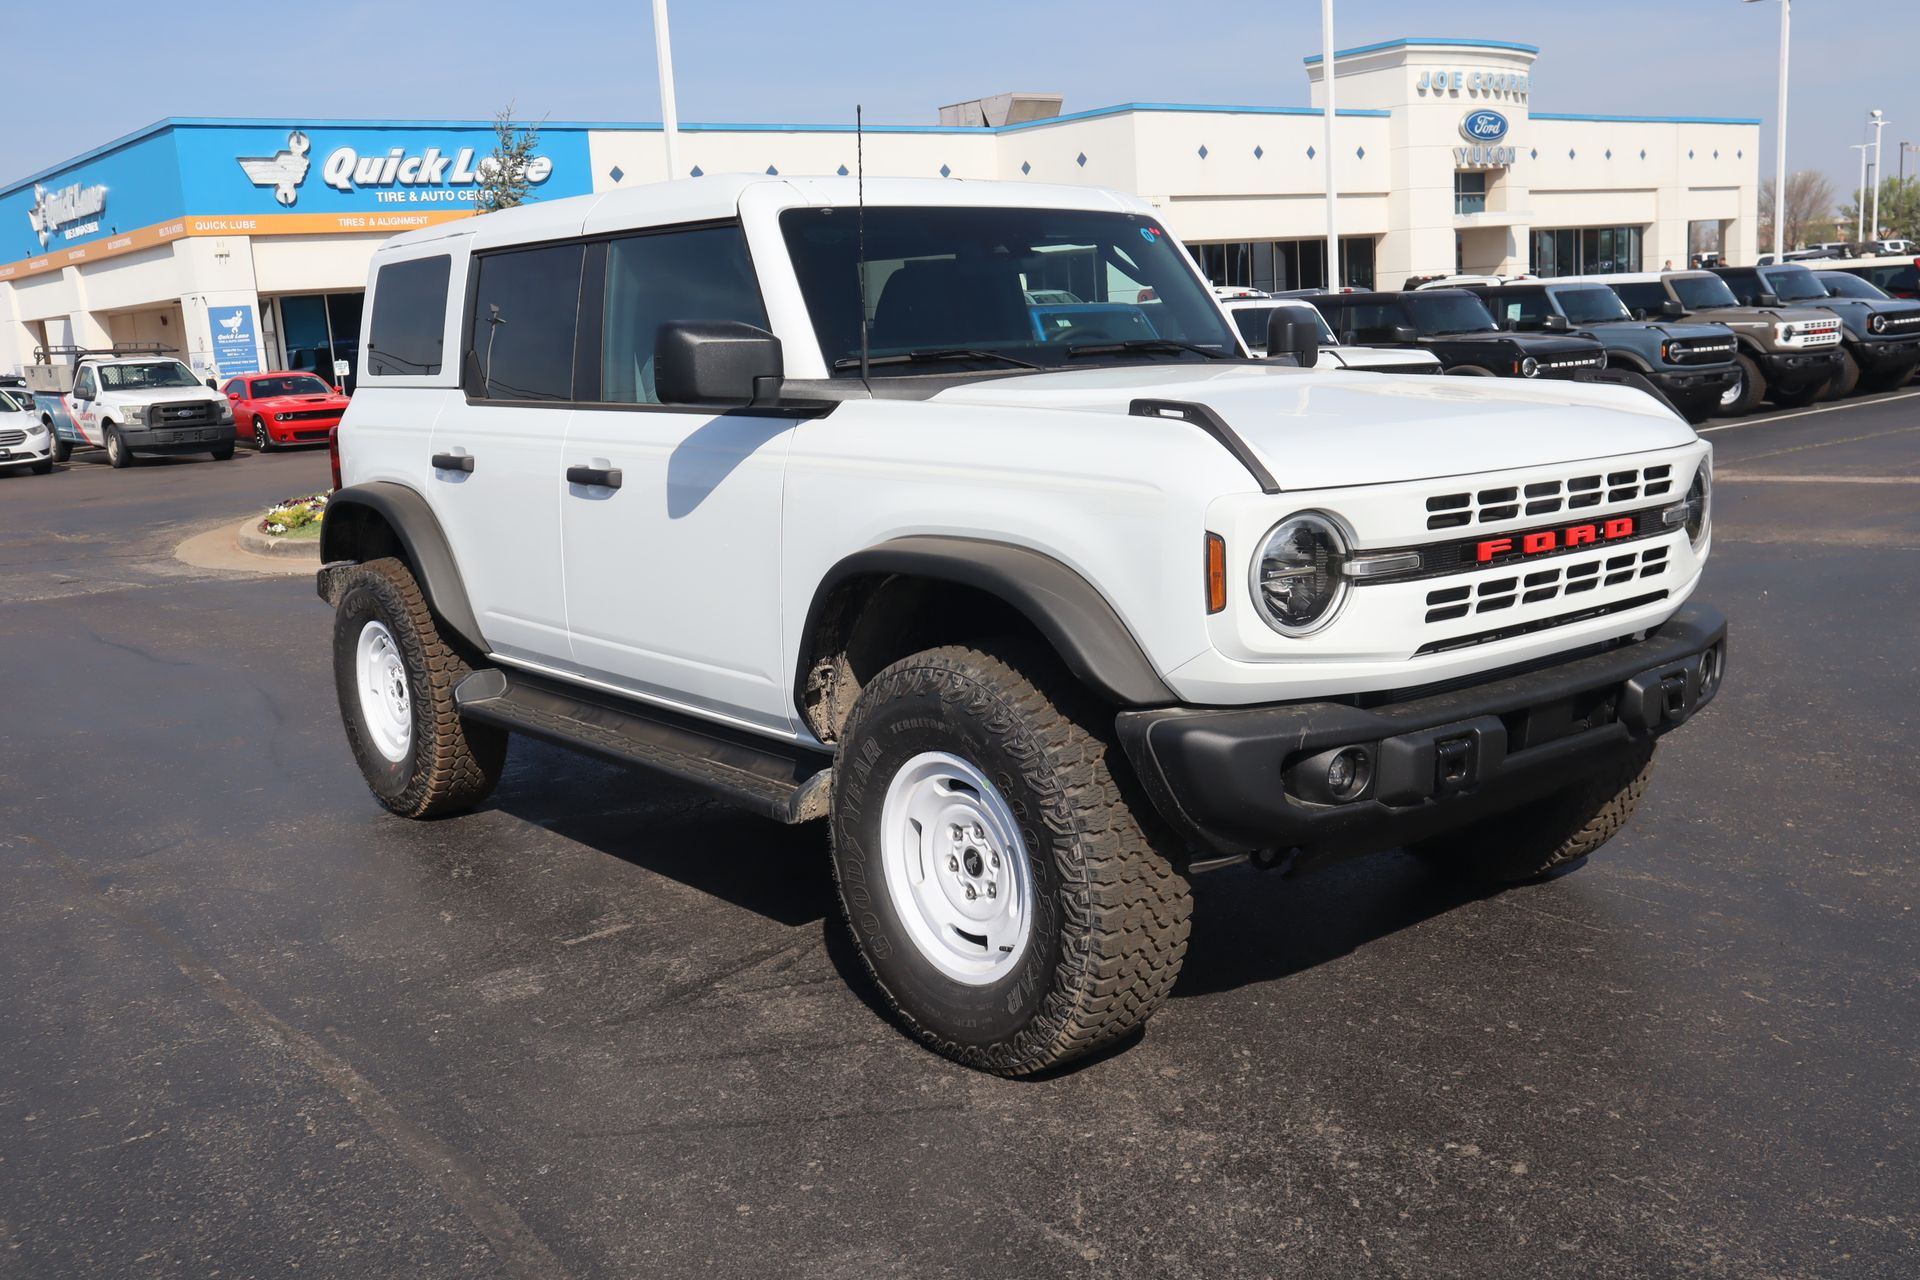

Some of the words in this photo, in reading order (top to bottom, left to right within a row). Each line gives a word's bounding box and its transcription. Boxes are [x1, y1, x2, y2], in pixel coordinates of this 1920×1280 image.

[1417, 71, 1462, 91] JOE
[1467, 72, 1533, 94] COOPER
[1474, 114, 1502, 135] Ford
[1453, 147, 1516, 165] YUKON
[322, 146, 450, 190] Quick
[450, 147, 553, 184] Lae
[376, 191, 406, 203] TIRE
[409, 191, 418, 202] &
[420, 190, 455, 202] AUTO
[195, 221, 228, 231] QUICK
[230, 220, 257, 230] LUBE
[337, 218, 365, 227] TIRES
[369, 217, 376, 226] &
[378, 216, 429, 226] ALIGNMENT
[1477, 516, 1634, 562] FORD
[837, 736, 895, 961] GOODYEAR
